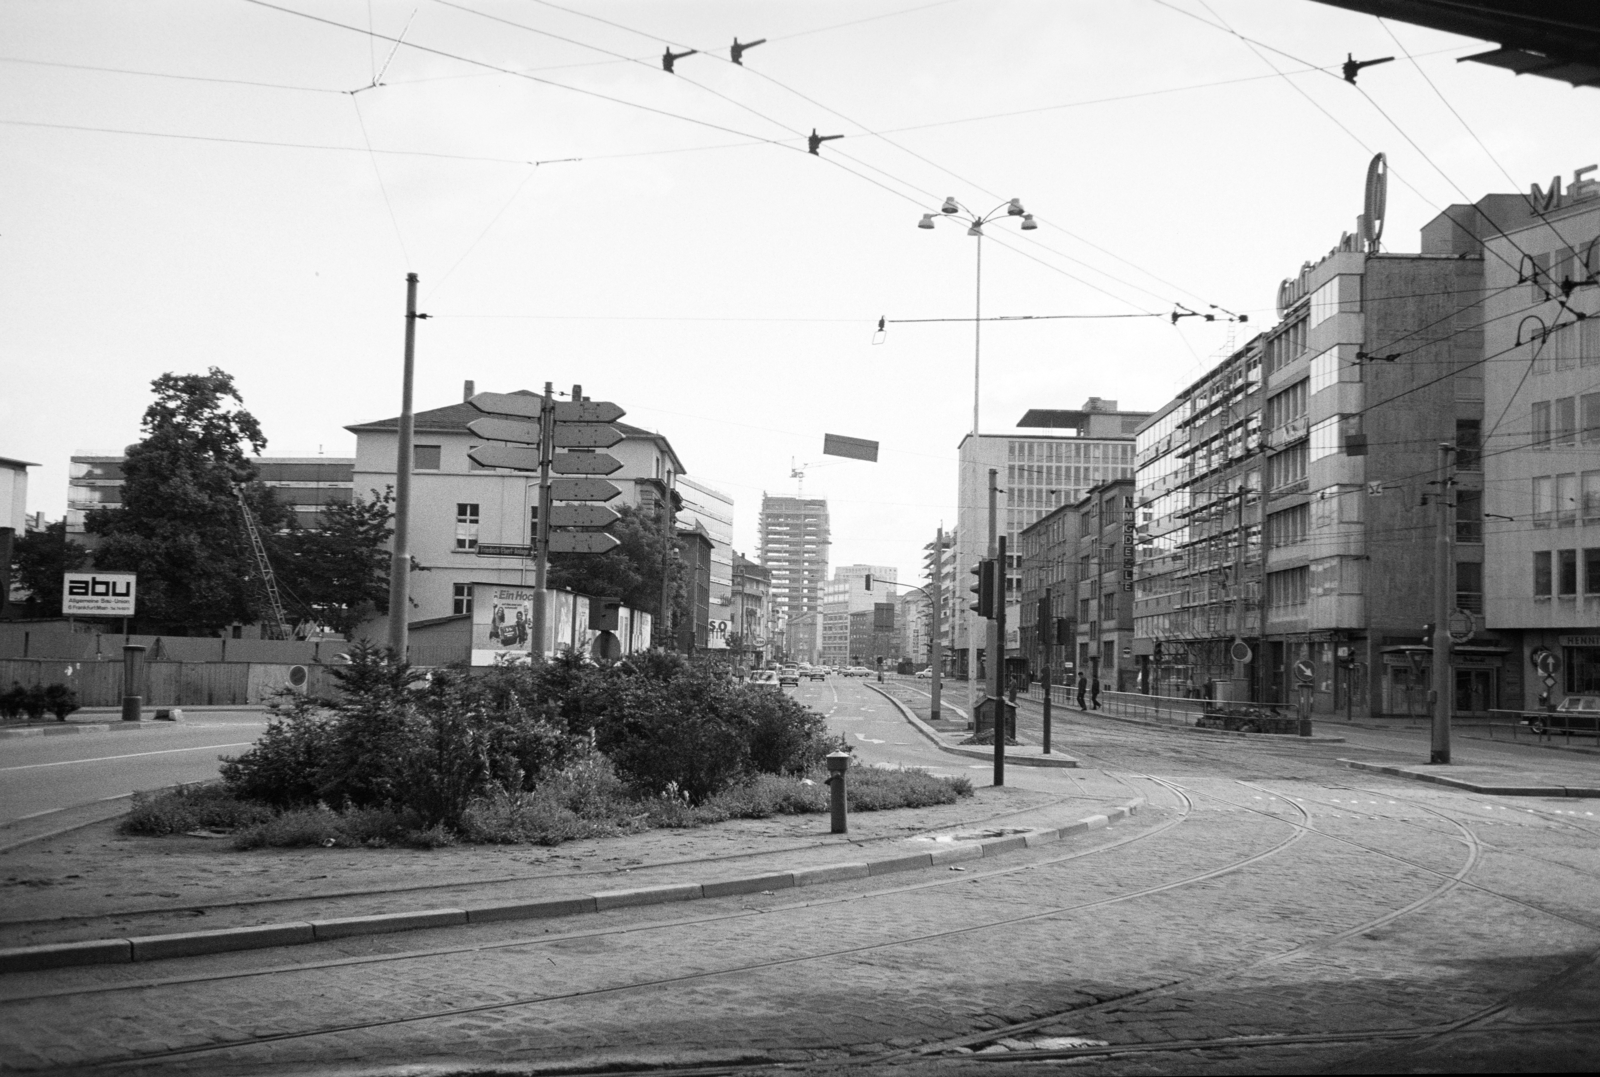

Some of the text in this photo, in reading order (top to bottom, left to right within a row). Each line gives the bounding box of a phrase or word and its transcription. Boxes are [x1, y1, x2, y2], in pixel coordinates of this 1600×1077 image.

[69, 576, 130, 597] abu
[499, 590, 534, 600] Ein Hoc
